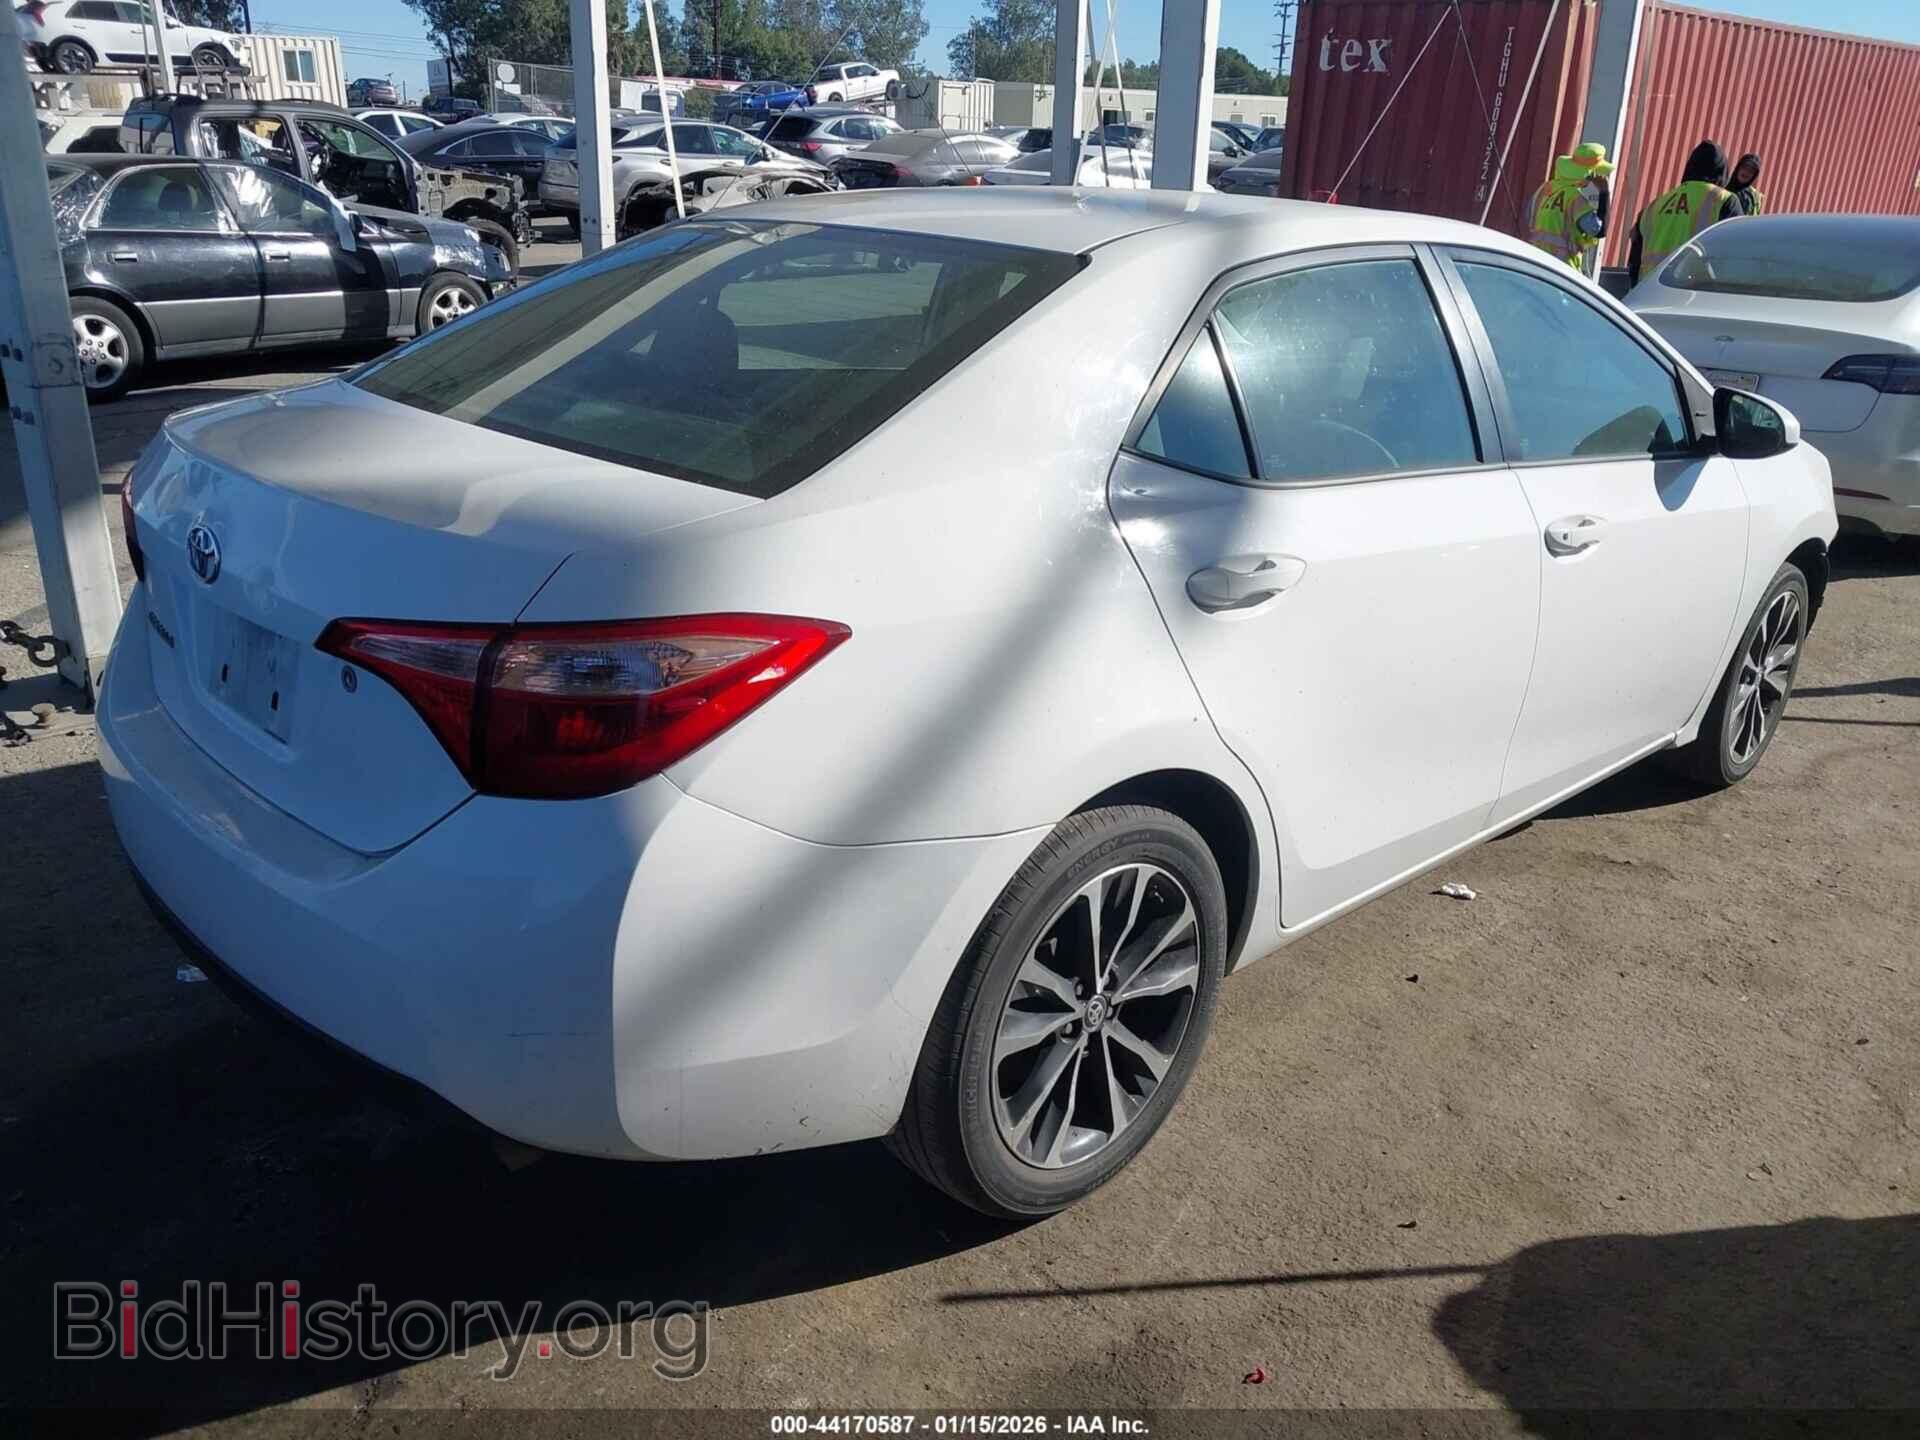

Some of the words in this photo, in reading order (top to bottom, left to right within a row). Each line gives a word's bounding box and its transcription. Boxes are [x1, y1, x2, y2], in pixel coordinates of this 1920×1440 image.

[1319, 27, 1391, 72] tex
[1498, 26, 1516, 87] TGHU
[1066, 838, 1120, 879] ENERGY
